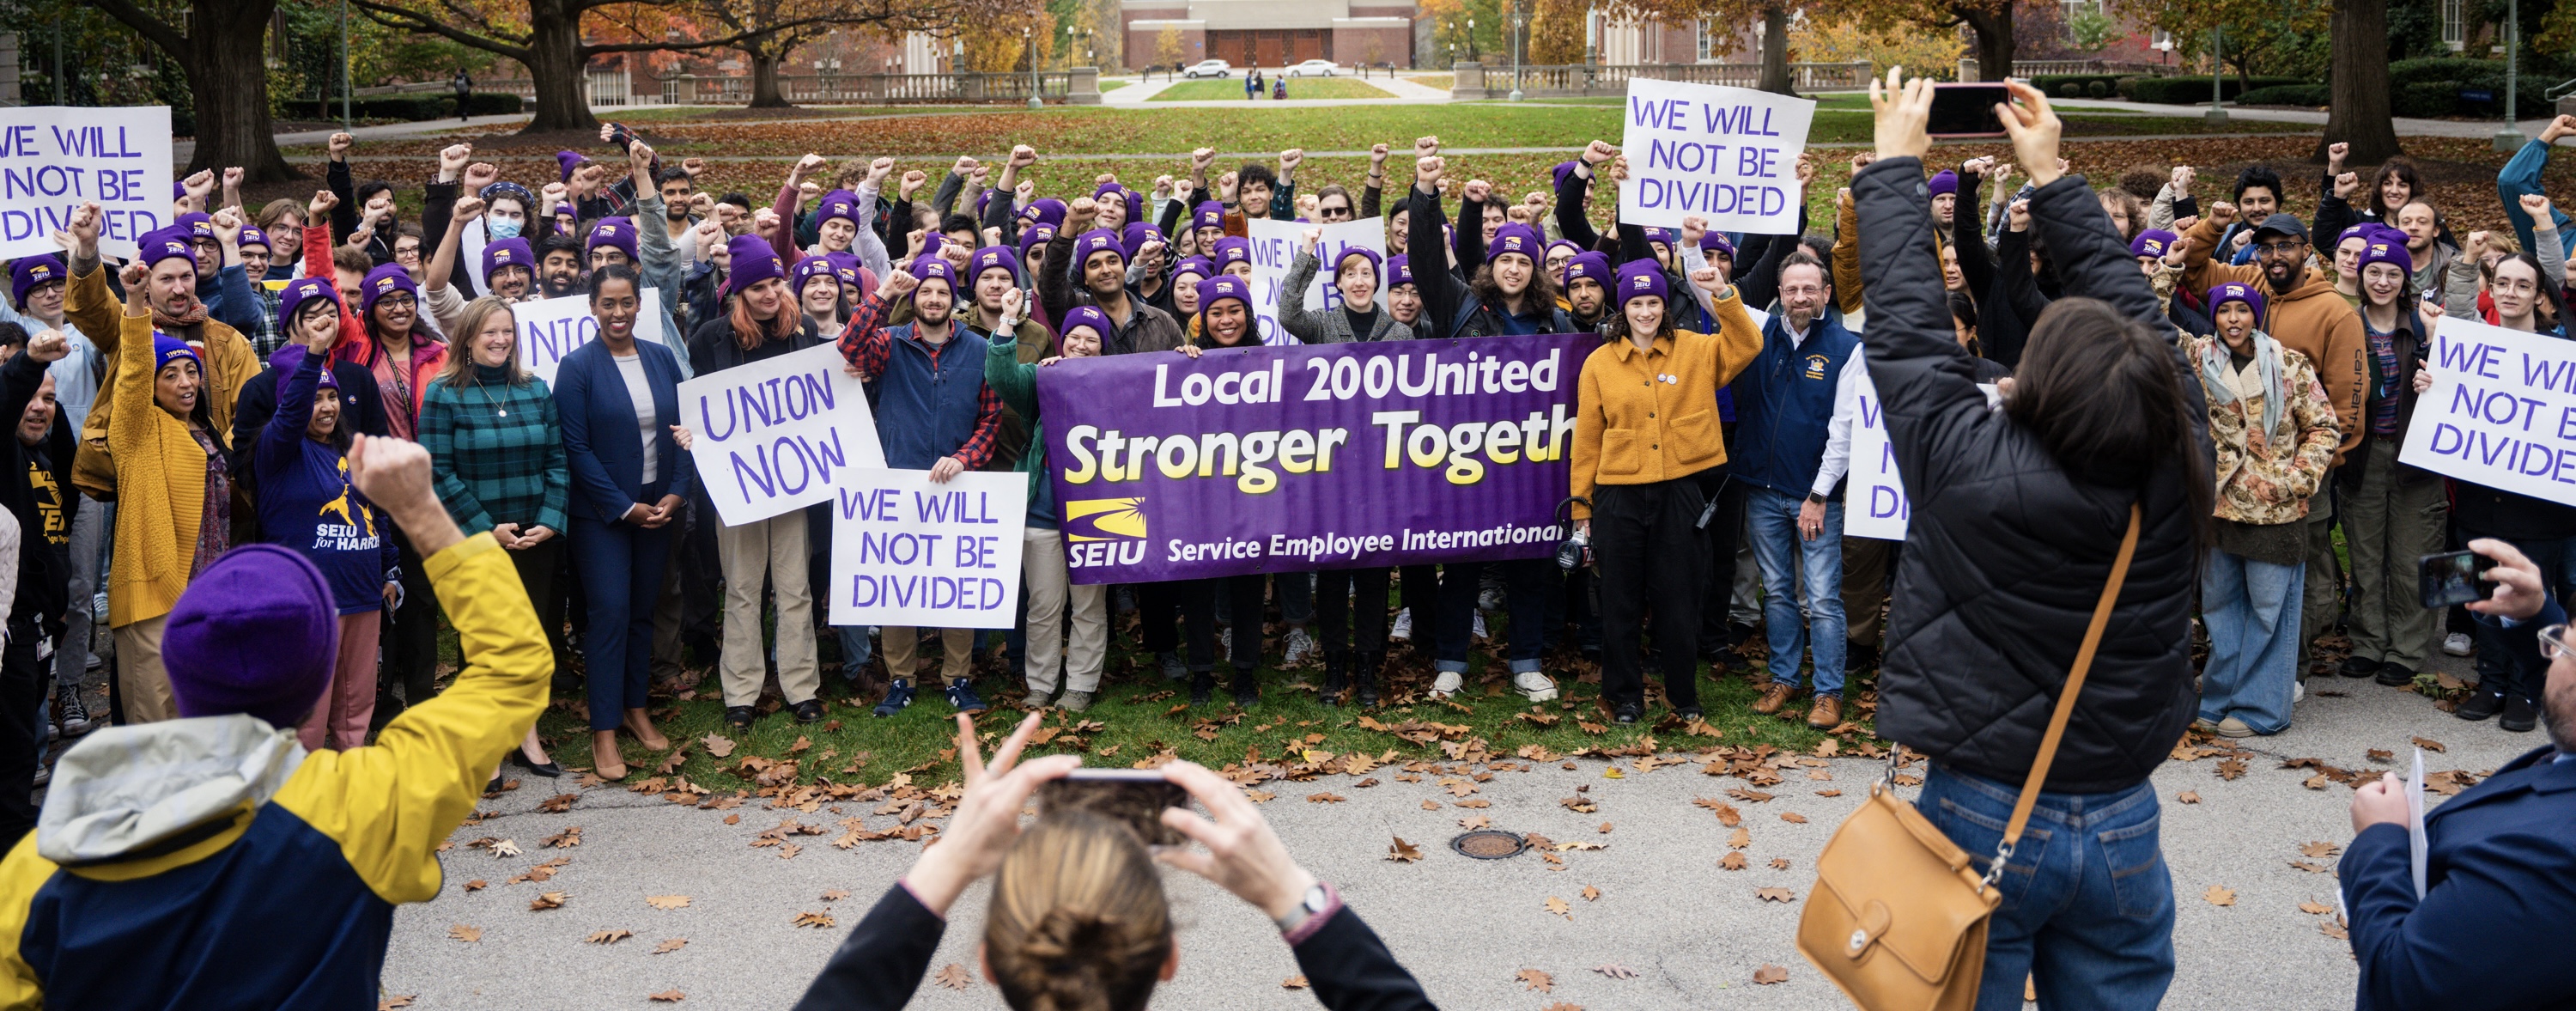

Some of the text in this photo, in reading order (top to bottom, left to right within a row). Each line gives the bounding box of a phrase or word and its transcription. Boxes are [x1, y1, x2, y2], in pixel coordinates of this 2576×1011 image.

[1633, 95, 1779, 137] WE WILL
[52, 125, 142, 158] WILL
[1649, 138, 1779, 178] NOT BE
[5, 165, 145, 202] NOT BE
[1639, 178, 1785, 216] DIVIDED
[1, 204, 158, 242] DIVED
[1252, 236, 1283, 269] WE
[380, 284, 394, 293] SEIU
[2439, 334, 2506, 380] WE
[1152, 359, 1284, 409] Local
[2346, 348, 2362, 431] carhartt
[701, 368, 835, 442] UNION
[2450, 382, 2547, 432] NOT
[729, 426, 847, 504] NOW
[1065, 404, 1577, 495] Stronger Togeth
[2429, 422, 2576, 485] DIVIDE
[839, 487, 999, 524] WE WILL
[312, 536, 334, 549] for
[316, 523, 358, 538] SEIU
[1168, 523, 1564, 563] Service Employee International
[860, 531, 999, 569] NOT BE
[1068, 541, 1146, 568] SEIU
[853, 575, 1005, 611] DIVIDED
